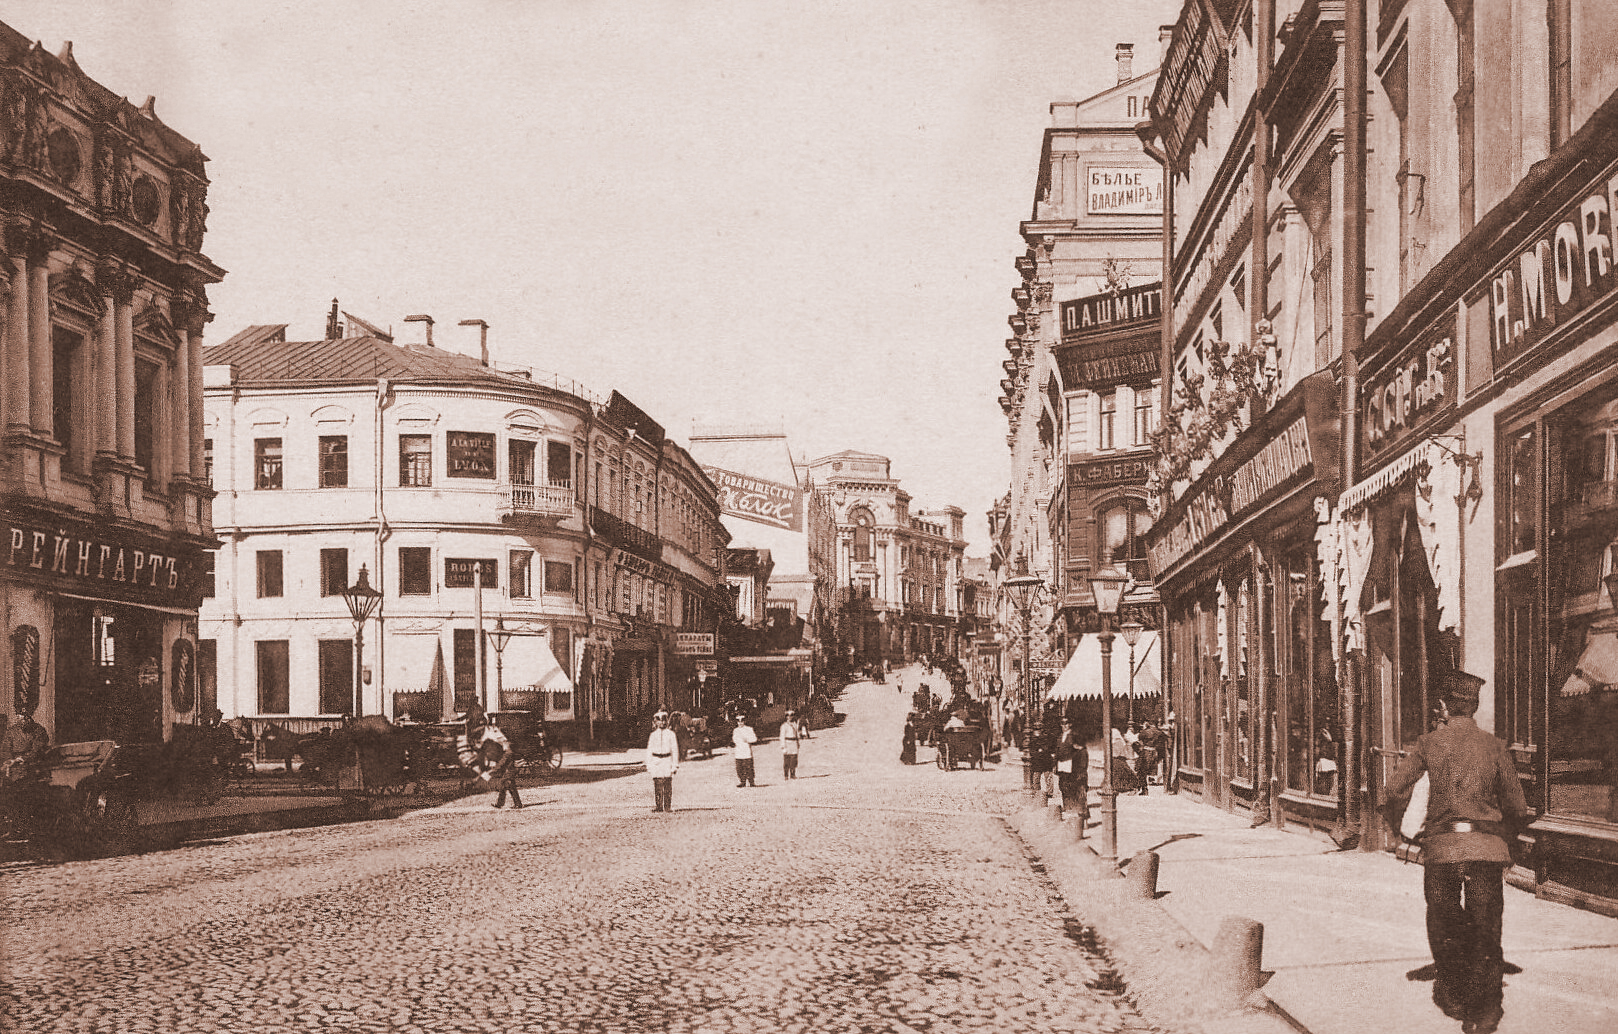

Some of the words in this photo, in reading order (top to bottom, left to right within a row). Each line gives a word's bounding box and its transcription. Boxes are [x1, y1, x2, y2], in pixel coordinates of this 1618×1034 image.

[1092, 172, 1142, 186] БѢЛЬЕ
[1092, 186, 1152, 211] ВЛАДИМІРЪ
[454, 459, 489, 471] LYON
[7, 527, 178, 589] РЕЙНГАРТЪ
